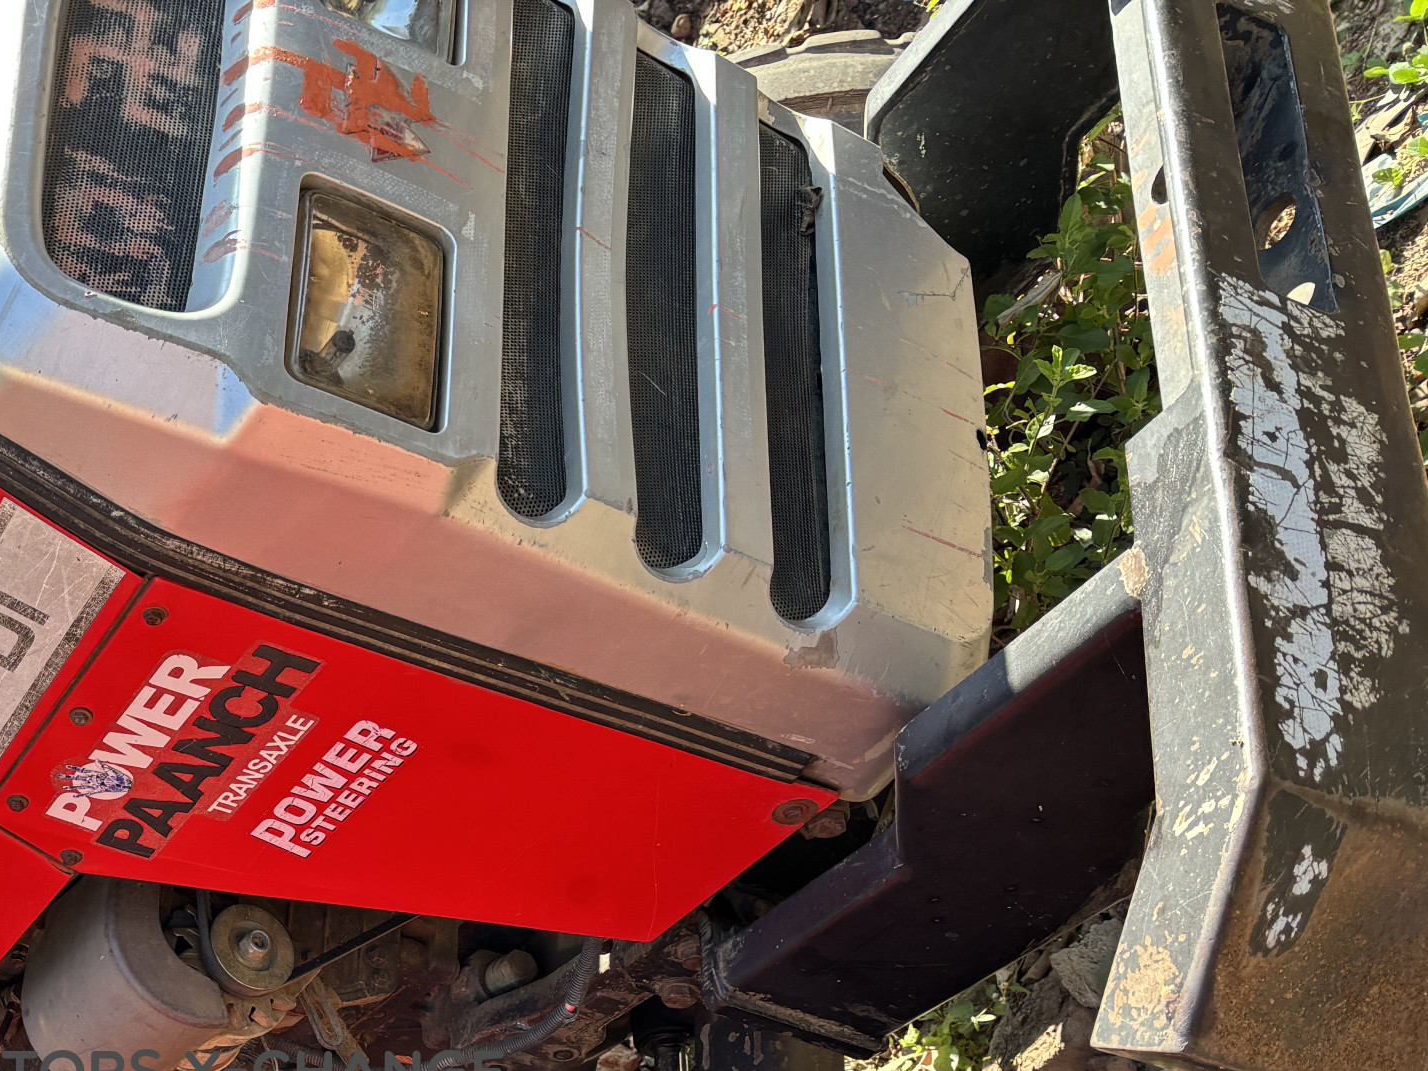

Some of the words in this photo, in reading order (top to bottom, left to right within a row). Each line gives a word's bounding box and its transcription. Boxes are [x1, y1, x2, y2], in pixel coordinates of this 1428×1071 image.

[45, 653, 232, 833] POWER
[97, 644, 323, 859] PAANCH
[207, 714, 315, 815] TRANSAXLE
[250, 719, 396, 859] POWER
[301, 737, 418, 847] STEERING
